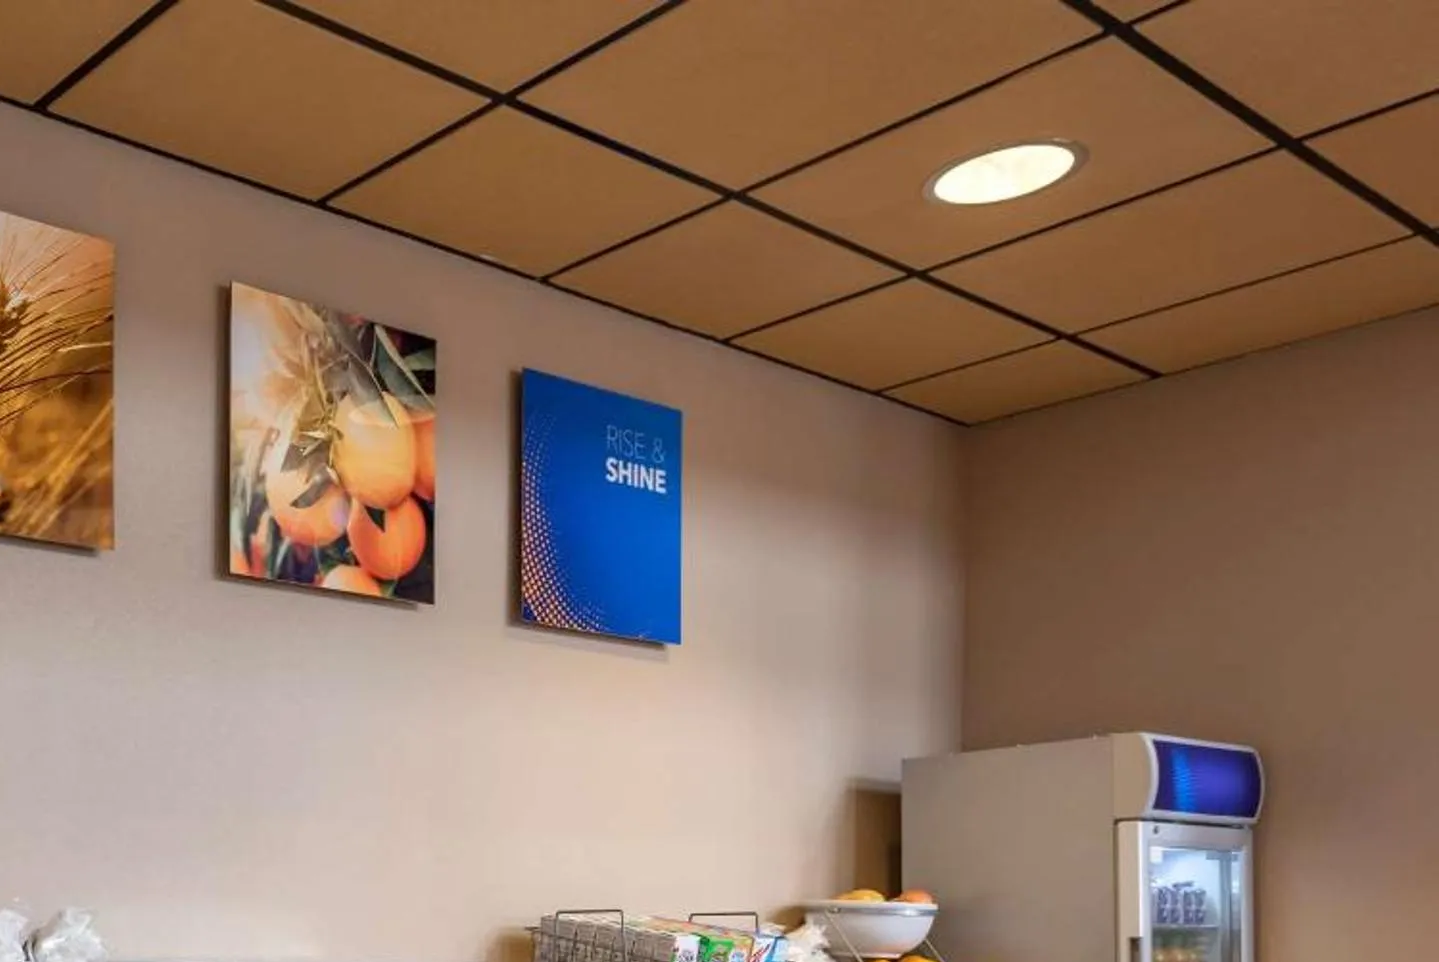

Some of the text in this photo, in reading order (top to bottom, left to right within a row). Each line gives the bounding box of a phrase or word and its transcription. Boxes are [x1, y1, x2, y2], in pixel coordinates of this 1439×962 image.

[606, 424, 665, 463] RISE &
[605, 456, 667, 494] SHINE
